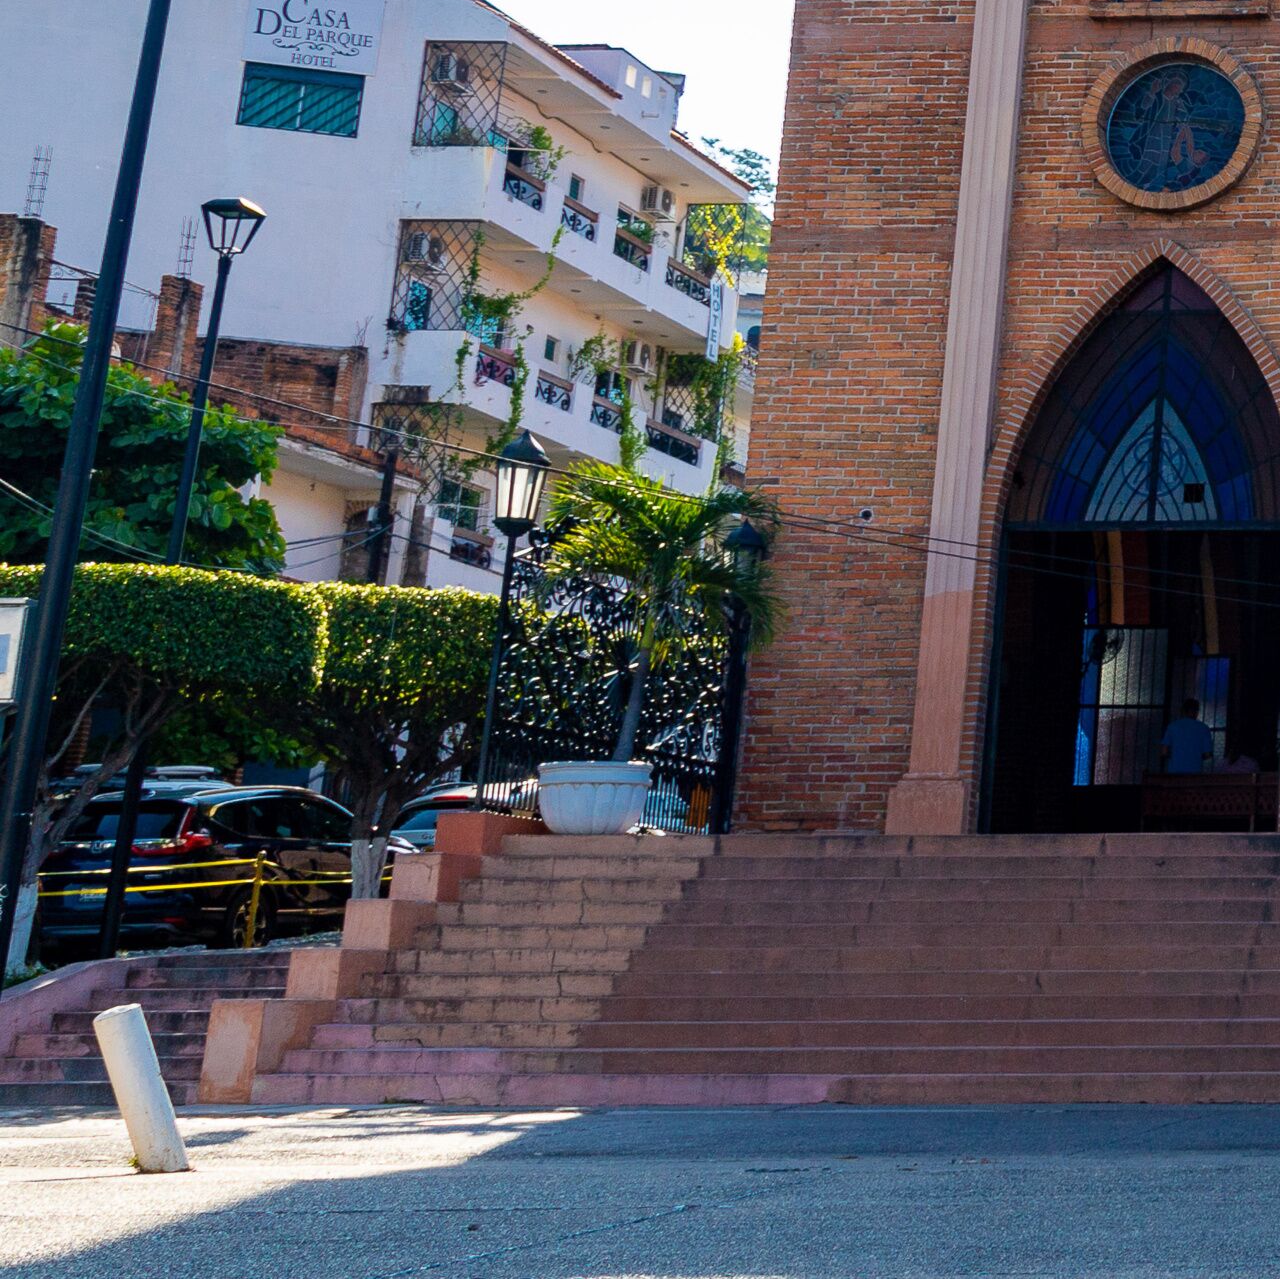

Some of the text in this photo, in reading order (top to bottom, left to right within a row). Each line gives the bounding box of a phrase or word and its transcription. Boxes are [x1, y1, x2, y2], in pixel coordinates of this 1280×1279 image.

[253, 8, 373, 49] DEL PARQUE
[290, 52, 337, 68] HOTEL
[709, 284, 720, 357] HOTEL
